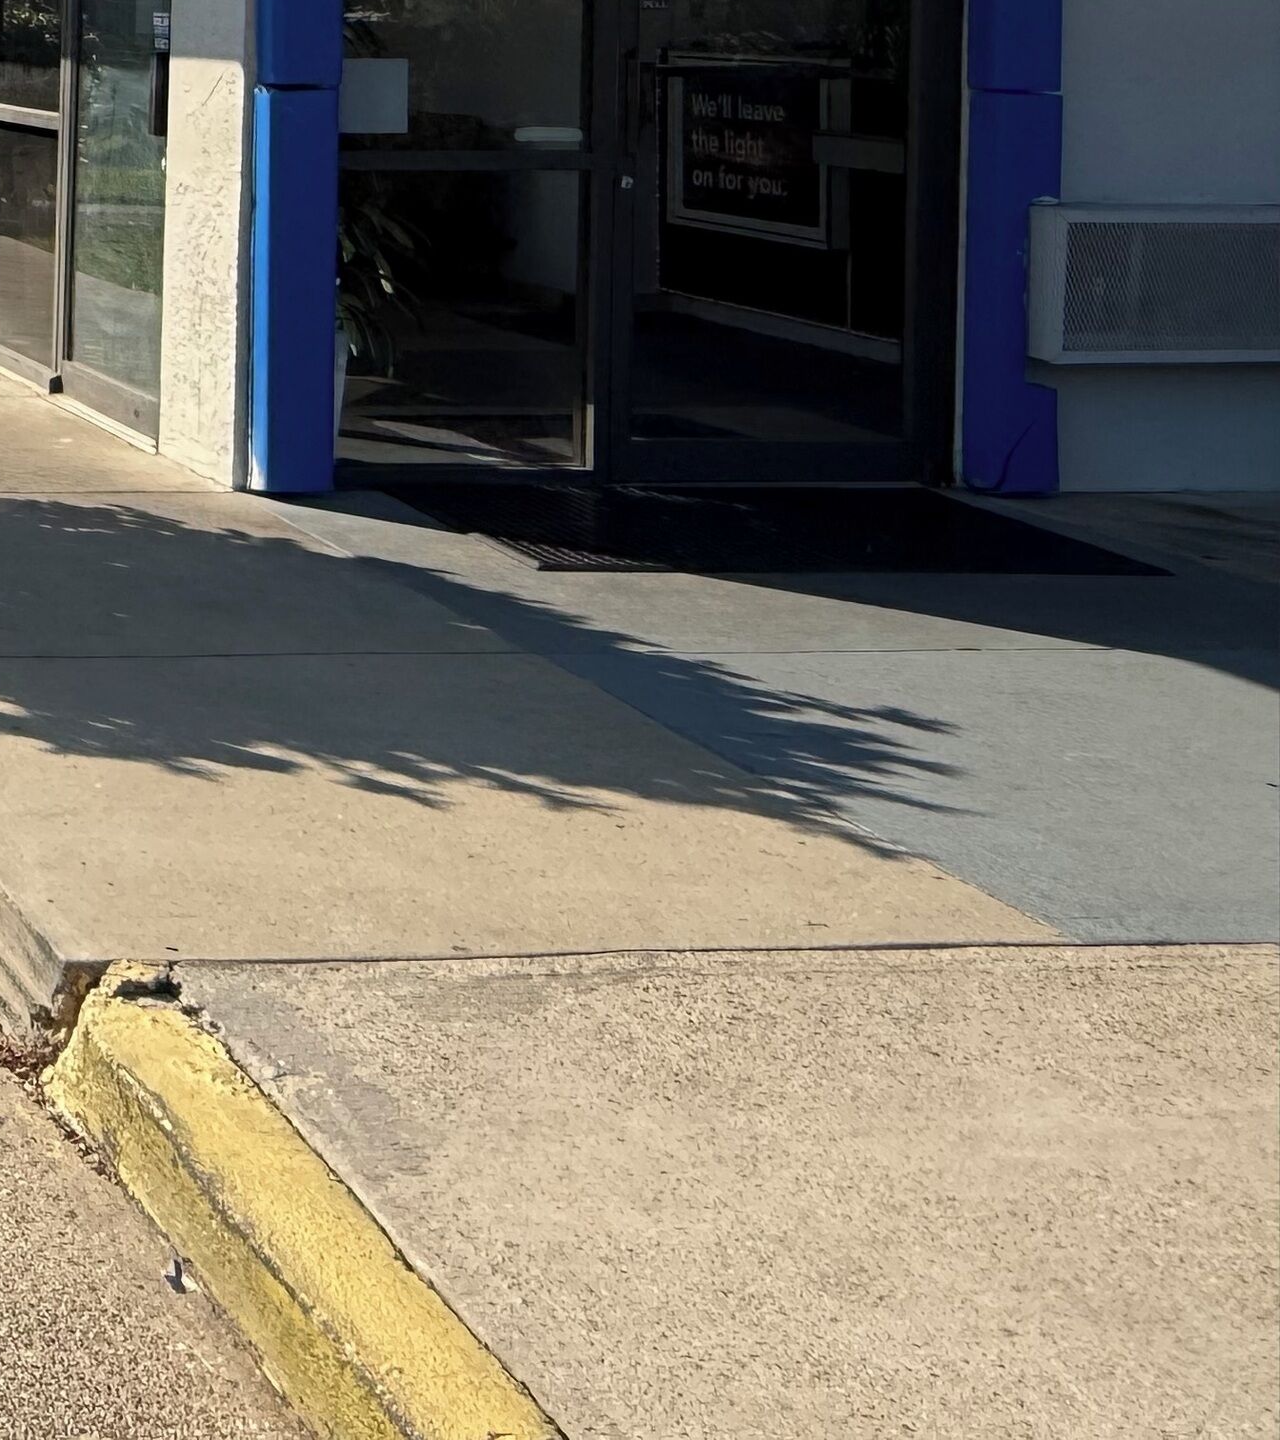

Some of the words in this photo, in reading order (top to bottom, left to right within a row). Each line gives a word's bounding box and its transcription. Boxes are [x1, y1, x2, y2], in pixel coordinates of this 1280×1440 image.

[691, 92, 732, 119] We'll
[738, 93, 786, 122] leave
[691, 127, 719, 153] the
[724, 129, 765, 160] light
[692, 168, 713, 188] on
[719, 164, 744, 190] for
[748, 177, 788, 200] you.
